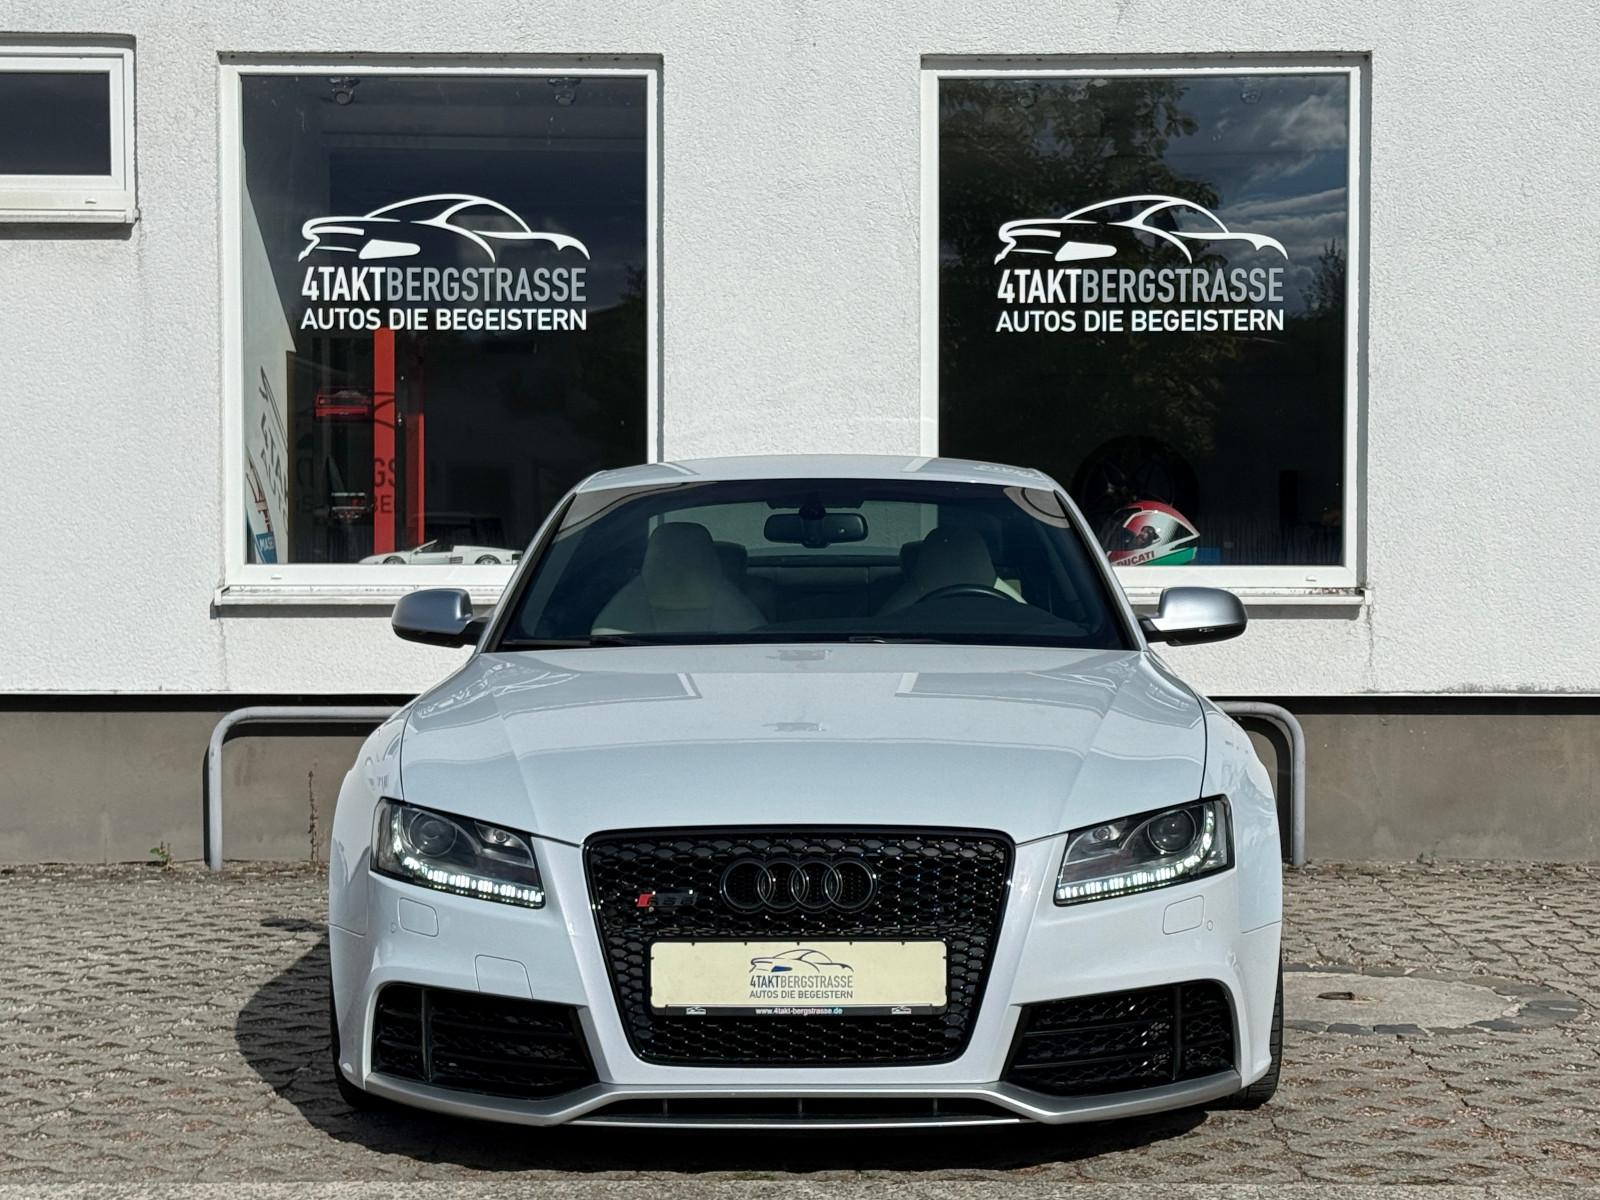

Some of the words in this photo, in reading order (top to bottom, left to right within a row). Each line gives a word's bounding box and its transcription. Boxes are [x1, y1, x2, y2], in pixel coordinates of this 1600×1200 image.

[301, 266, 587, 302] 4TAKTBERGSTRASSE
[996, 267, 1284, 304] 4TAKTBERGSTRASSE
[300, 308, 382, 331] AUTOS
[389, 308, 429, 331] DIE
[435, 308, 587, 331] BEGEISTERN
[995, 310, 1077, 333] AUTOS
[1084, 310, 1124, 332] DIE
[1131, 309, 1284, 332] BEGEISTERN
[749, 975, 853, 988] 4TAKTBERGSTRASSE
[749, 990, 779, 999] AUTOS
[781, 990, 796, 999] DIE
[798, 990, 853, 999] BEGEISTERN
[755, 1007, 843, 1016] www.4takt-bergstrasse.de
